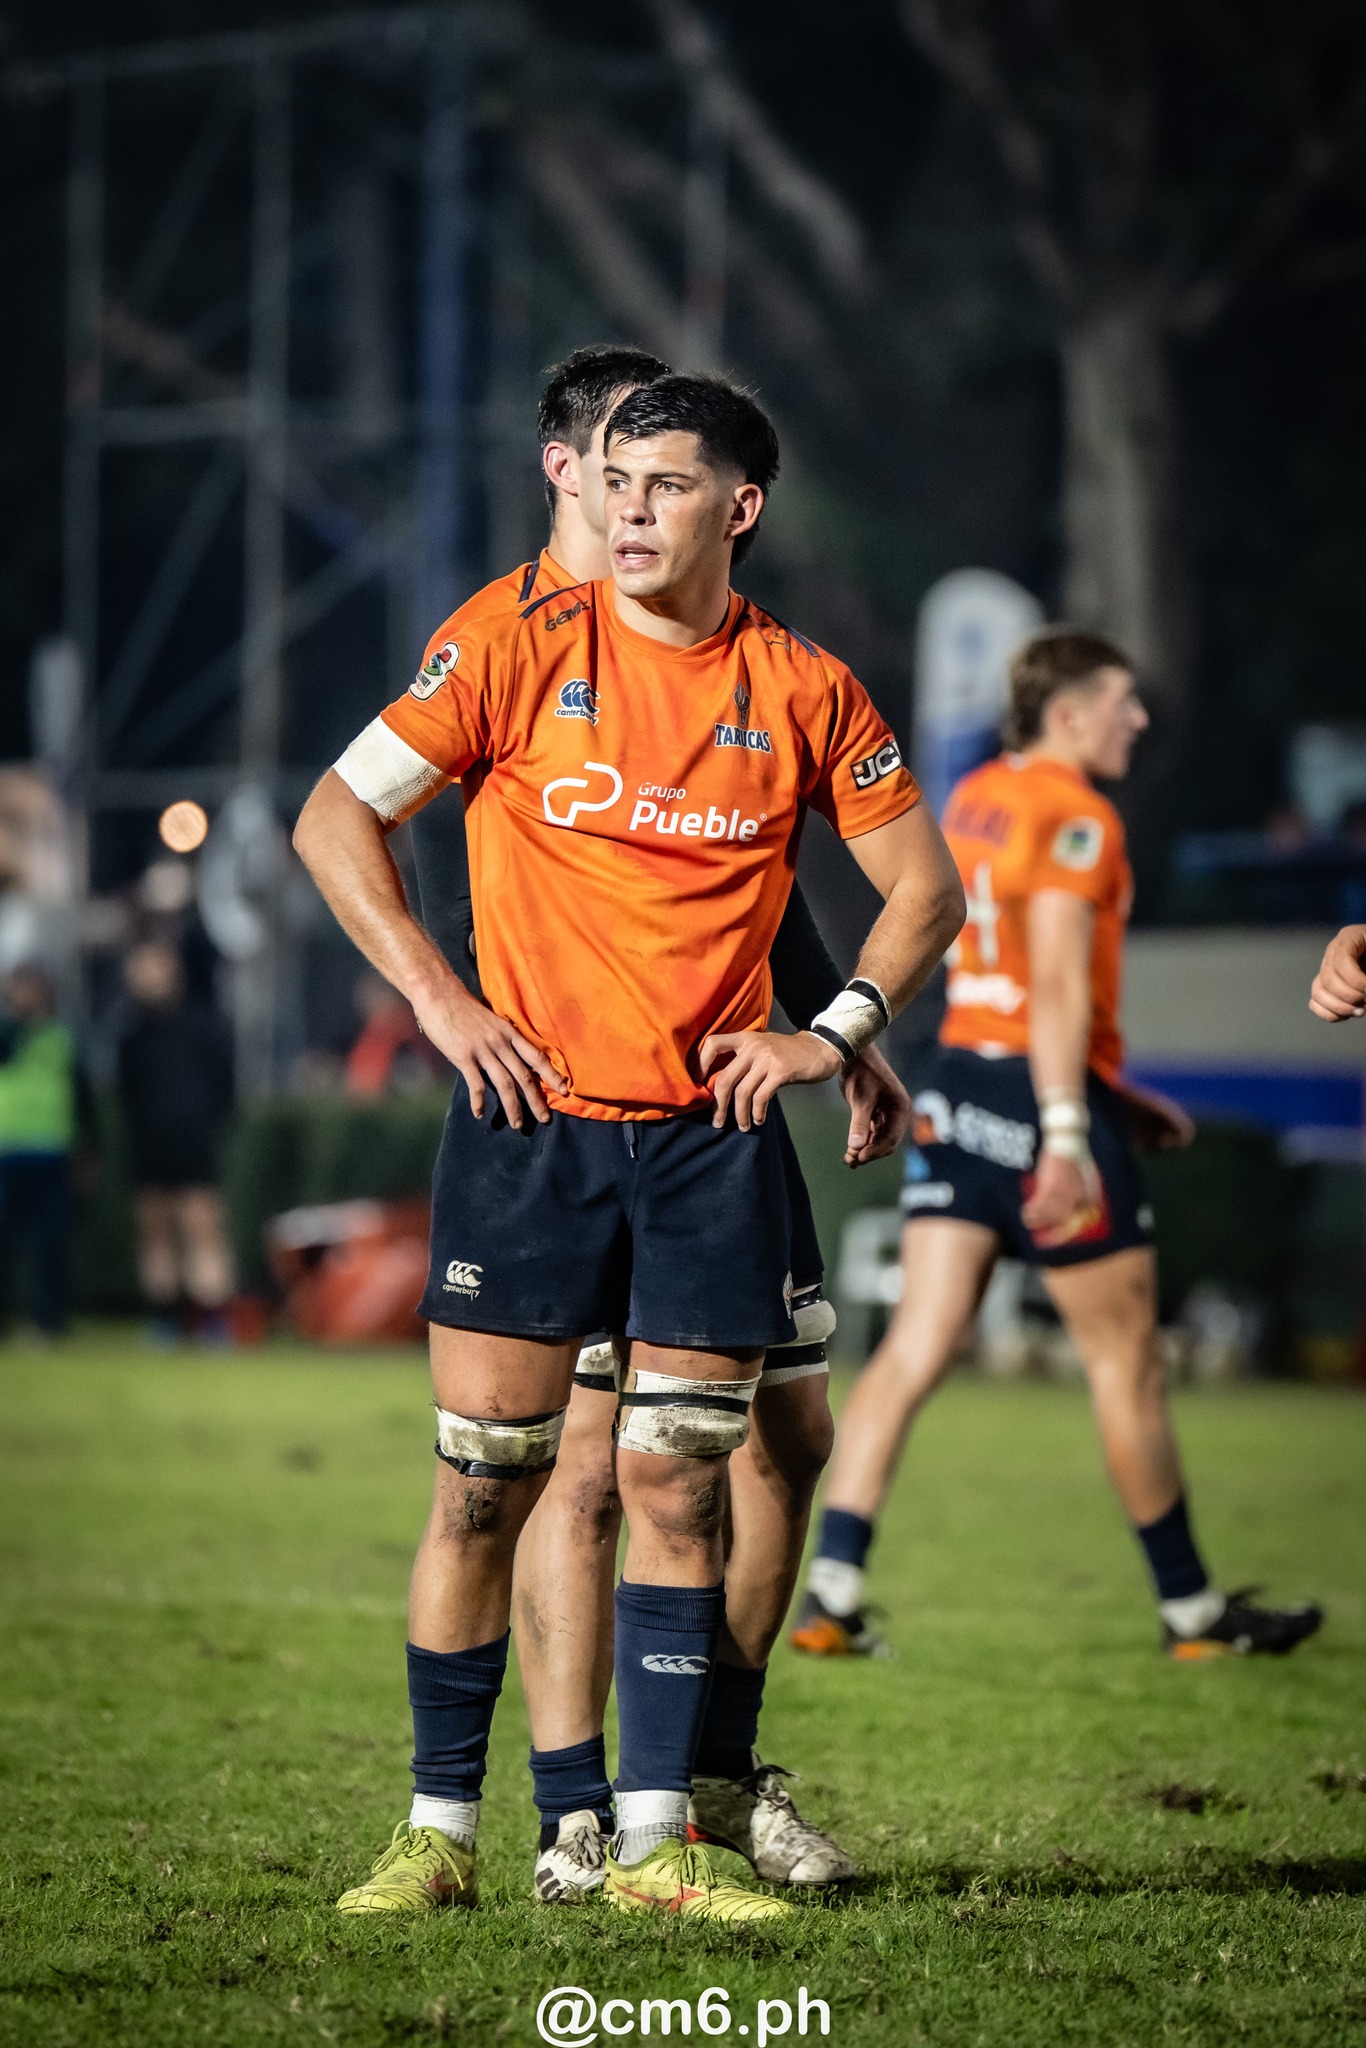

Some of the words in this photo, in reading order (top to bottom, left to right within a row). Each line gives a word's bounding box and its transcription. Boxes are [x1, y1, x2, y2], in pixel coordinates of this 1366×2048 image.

[856, 742, 902, 786] JC
[638, 782, 687, 802] Grupo
[442, 1283, 481, 1300] canterbury
